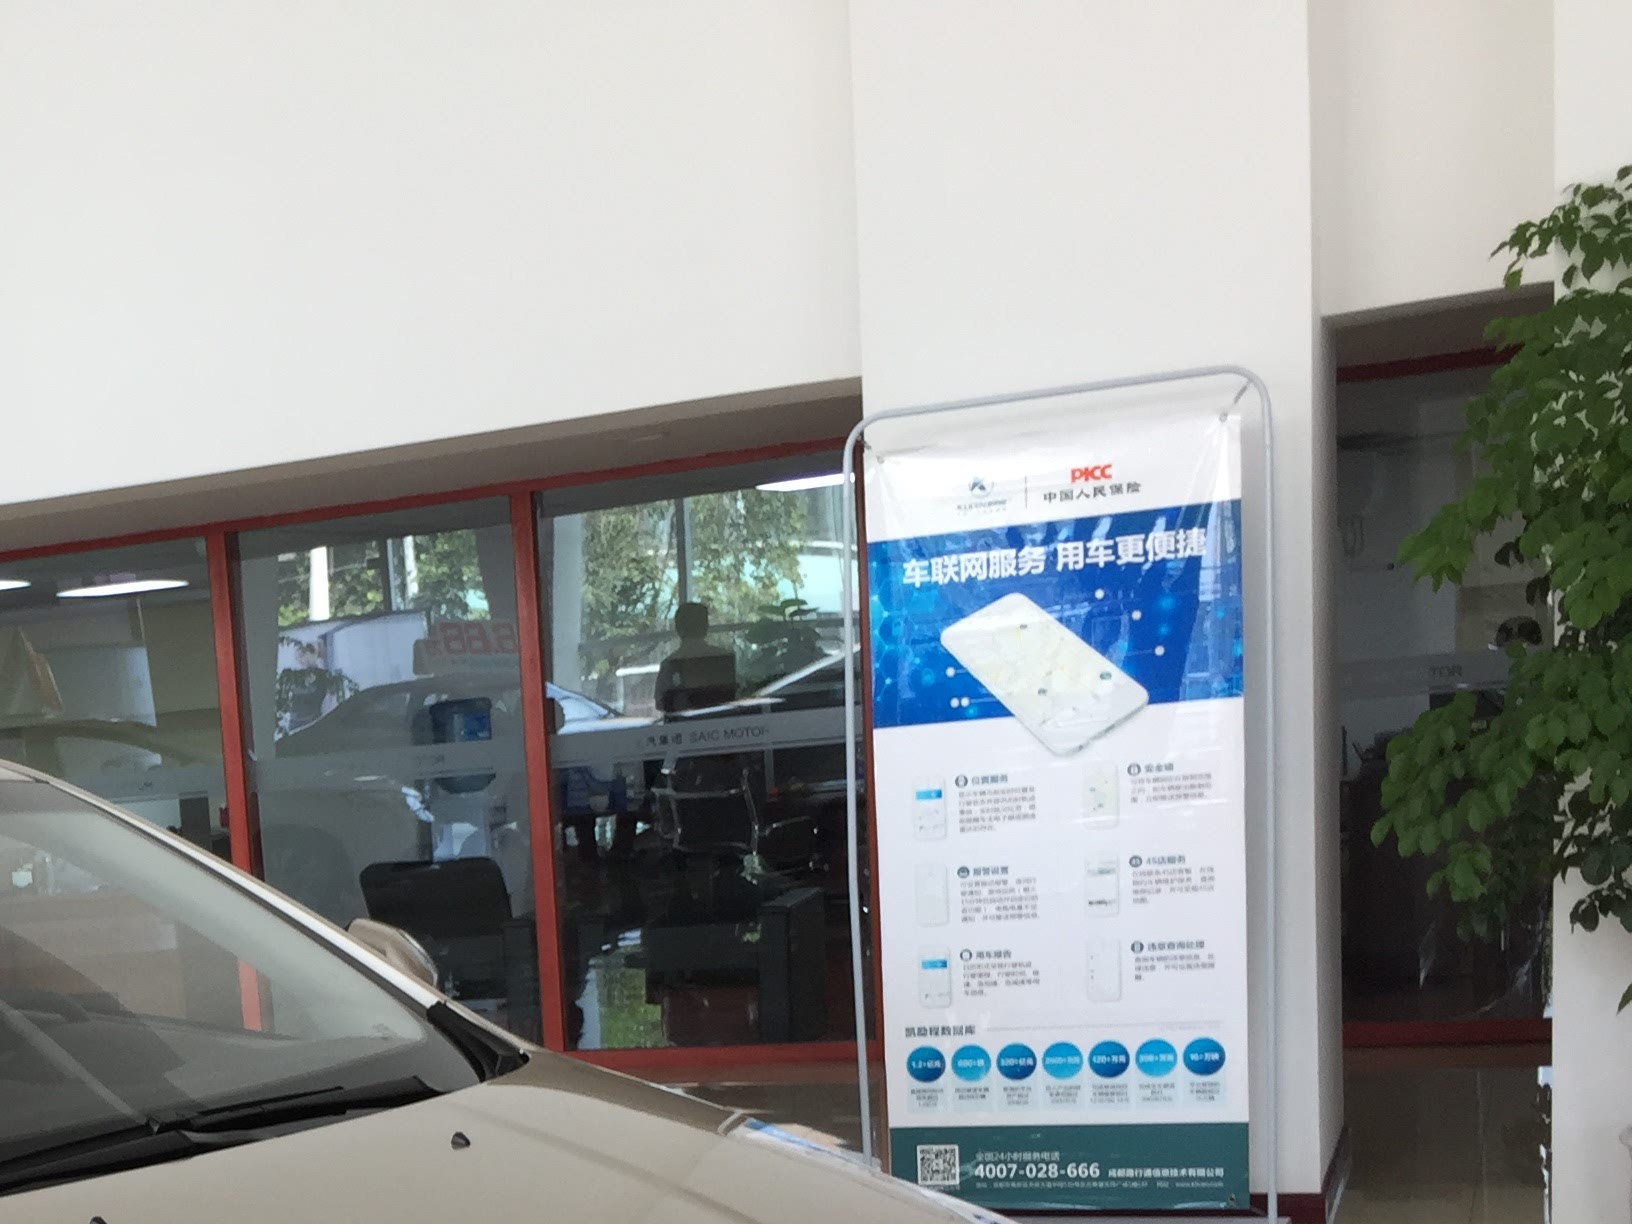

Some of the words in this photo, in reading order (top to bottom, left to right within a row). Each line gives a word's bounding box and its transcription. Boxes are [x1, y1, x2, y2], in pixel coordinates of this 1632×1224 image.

[1071, 463, 1112, 483] PICC
[1043, 481, 1141, 503] 中国人民保险
[902, 545, 1046, 588] 车联网服务
[1055, 527, 1207, 572] 用车更便捷
[974, 1162, 1100, 1179] 4007-028-666
